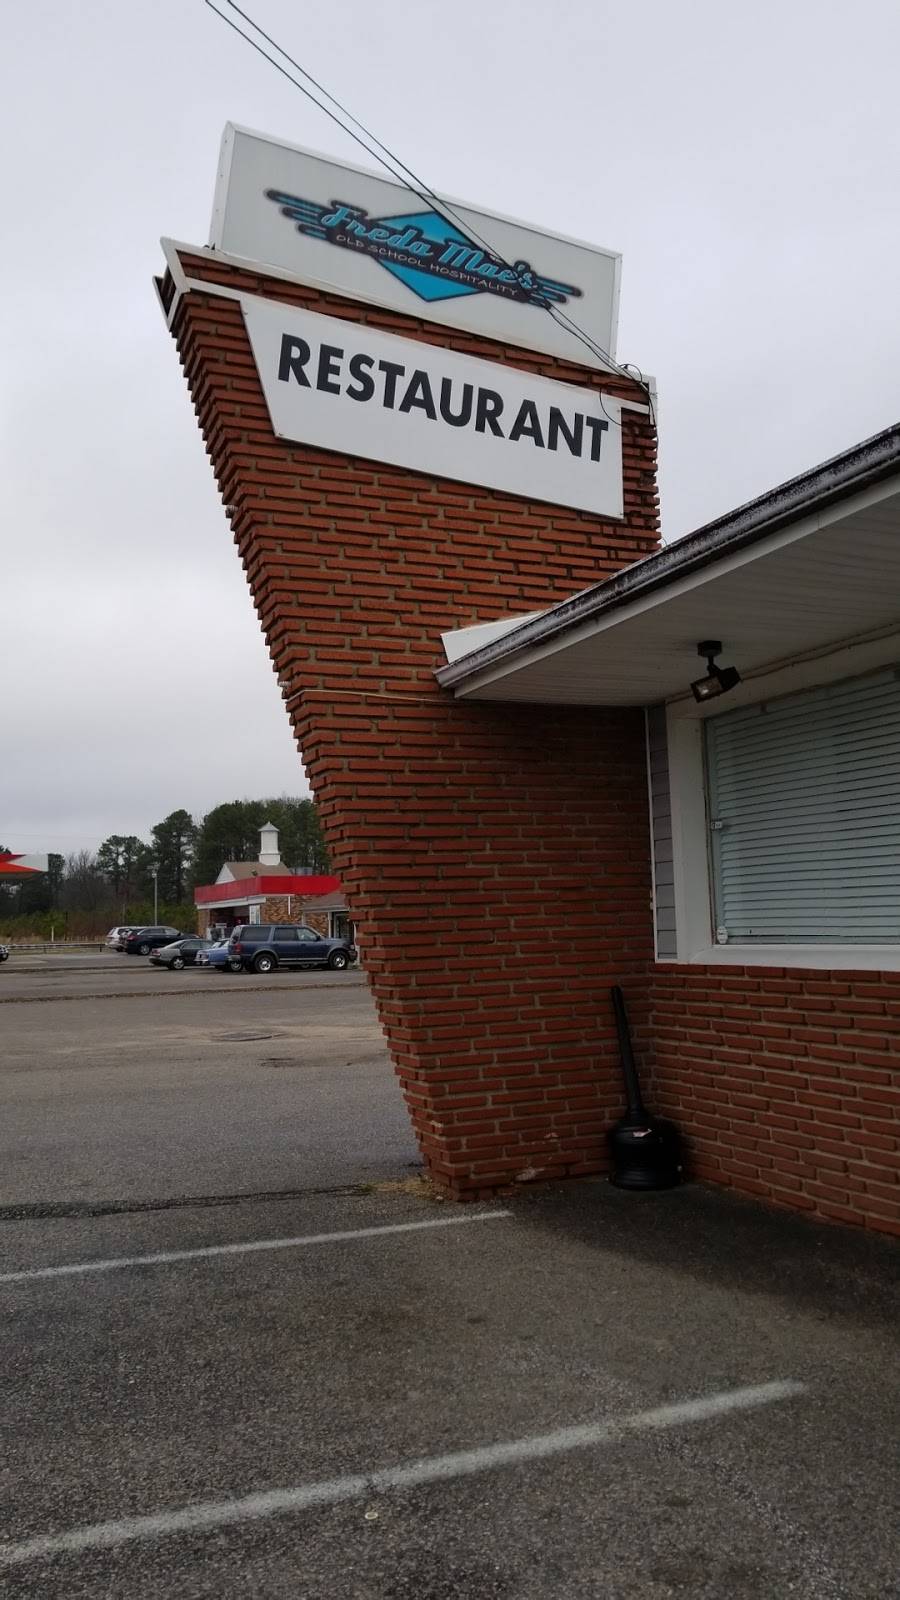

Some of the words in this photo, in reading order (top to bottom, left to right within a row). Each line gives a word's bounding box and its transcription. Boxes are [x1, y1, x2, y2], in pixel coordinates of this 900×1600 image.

[320, 205, 434, 256] Freda
[438, 241, 537, 290] Mae's
[336, 234, 365, 249] OLD
[369, 246, 428, 268] SCHOOL
[430, 262, 518, 296] HOSPITALITY
[277, 333, 609, 462] RESTAURANT
